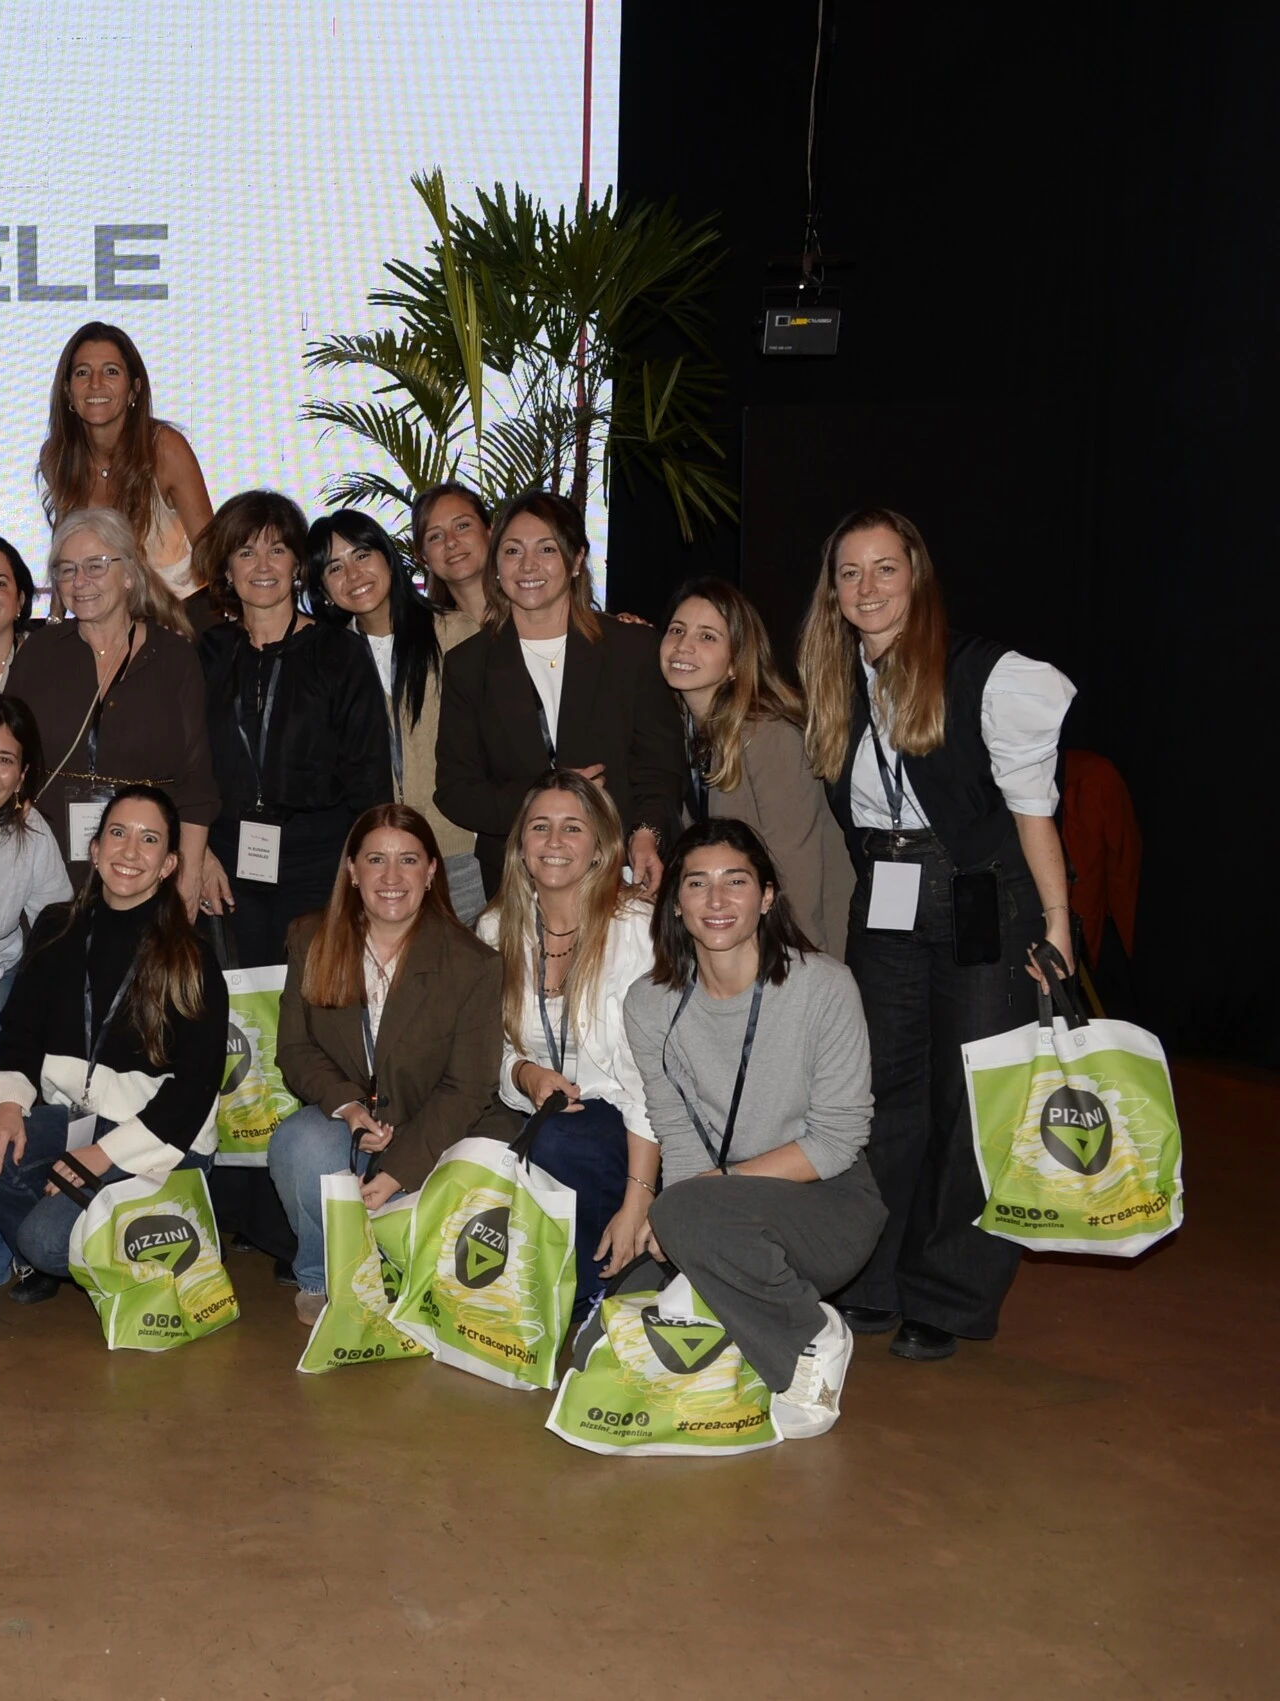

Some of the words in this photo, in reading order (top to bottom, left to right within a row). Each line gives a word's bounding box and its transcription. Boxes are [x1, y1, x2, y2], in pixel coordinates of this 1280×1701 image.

[128, 1226, 189, 1258] PIZZINI
[193, 1294, 237, 1324] #creaconp
[580, 1420, 653, 1438] pizzini_argentina
